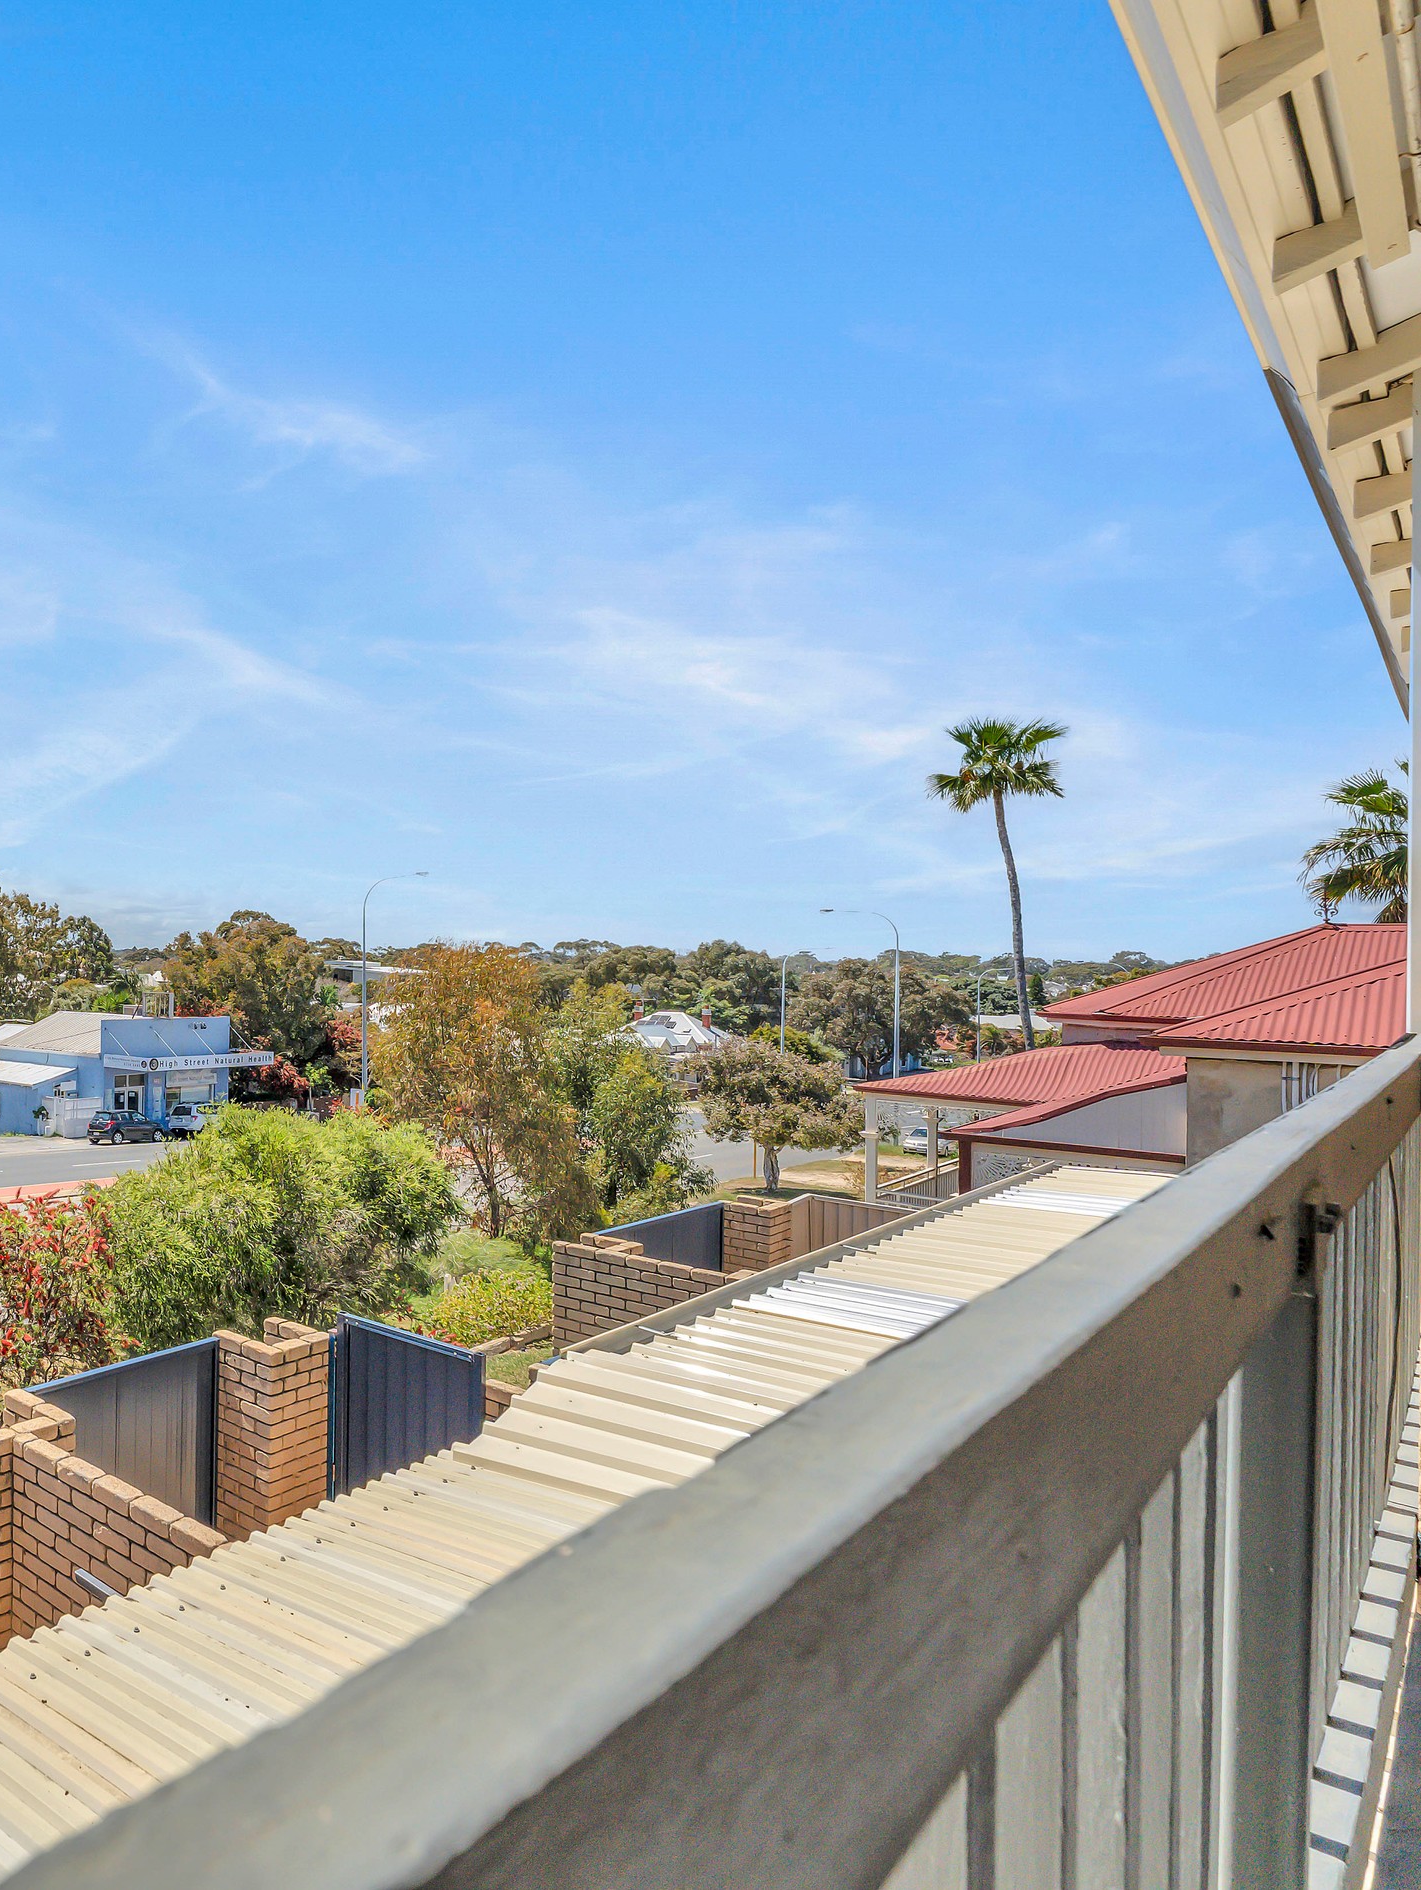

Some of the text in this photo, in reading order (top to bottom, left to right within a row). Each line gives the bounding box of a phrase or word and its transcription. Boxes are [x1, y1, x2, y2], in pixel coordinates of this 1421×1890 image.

[159, 1060, 178, 1069] High
[184, 1058, 209, 1066] Street
[214, 1056, 243, 1064] Natural
